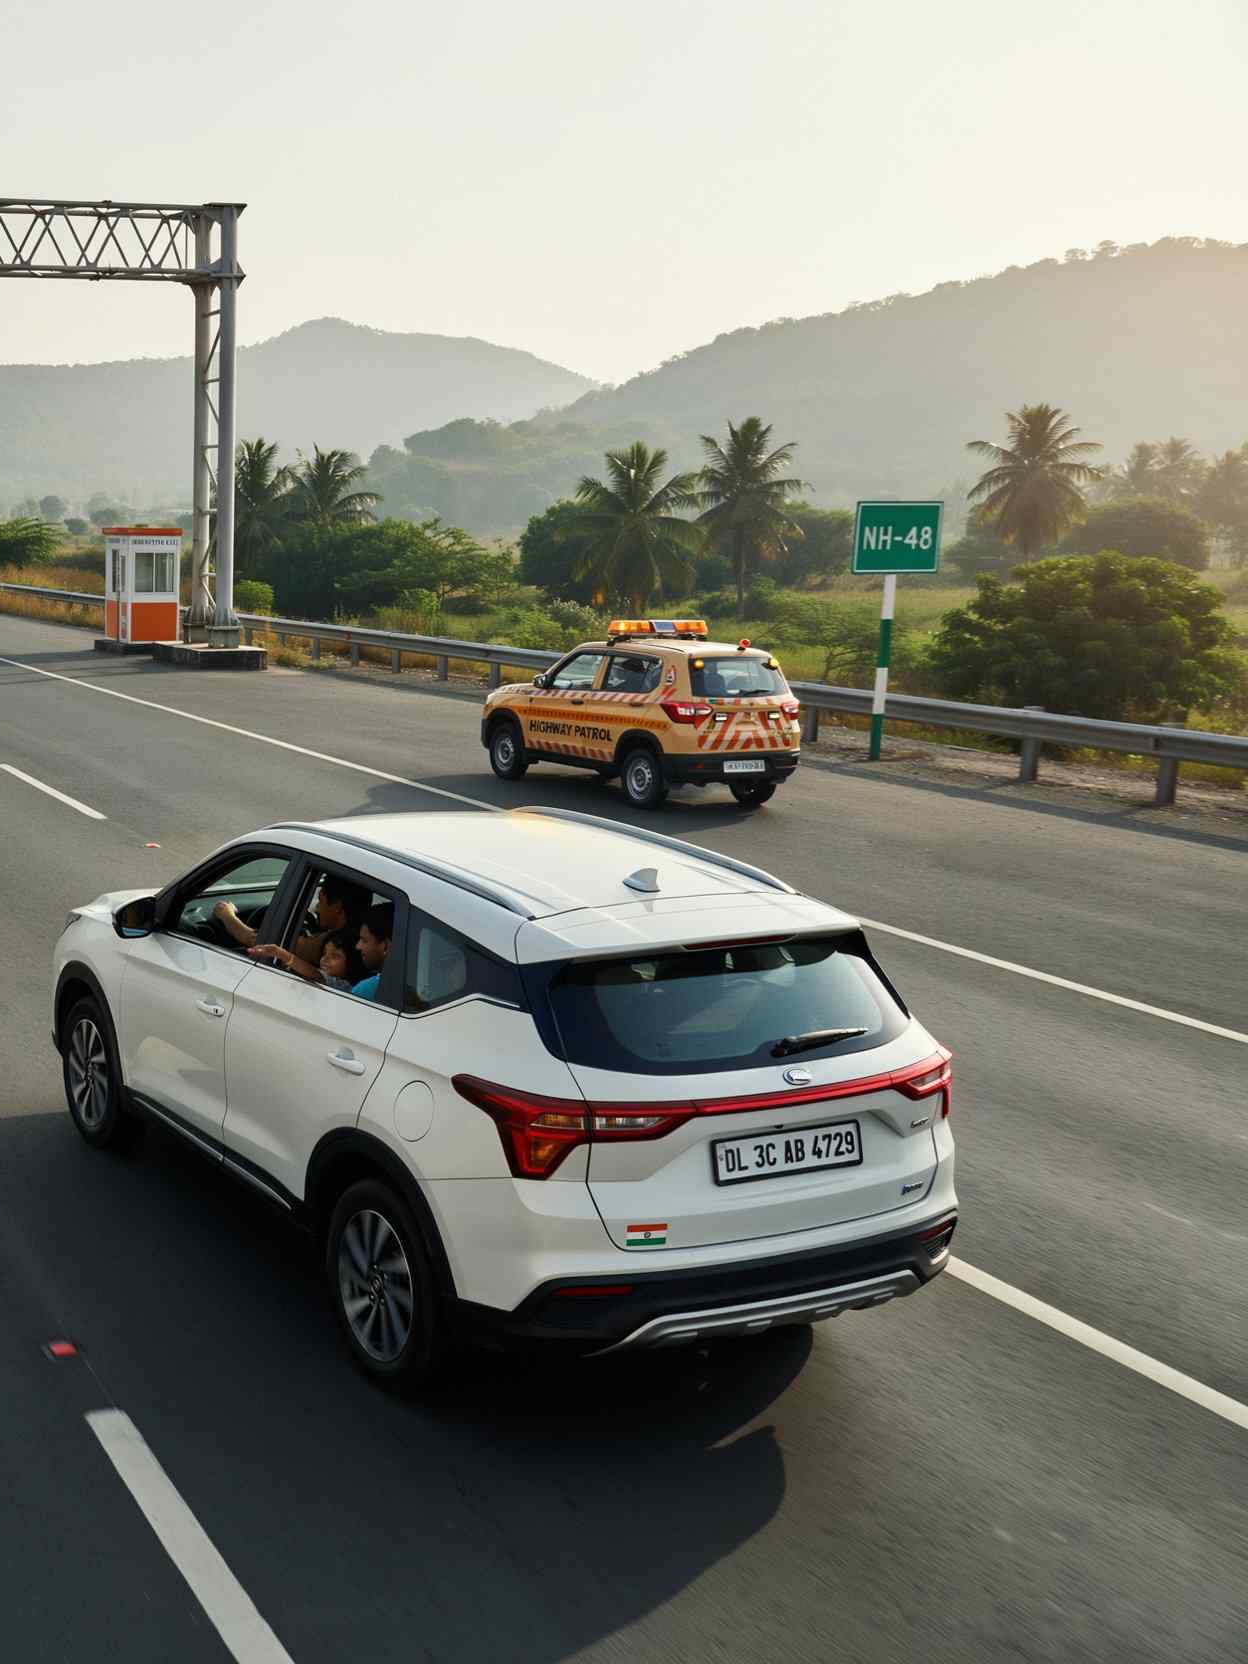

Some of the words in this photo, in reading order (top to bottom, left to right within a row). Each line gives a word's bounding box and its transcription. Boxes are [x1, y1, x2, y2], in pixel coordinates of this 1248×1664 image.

[863, 526, 933, 550] NH-48
[529, 719, 572, 737] HIGHWAY
[575, 725, 613, 741] PATROL
[725, 1147, 749, 1172] DL
[753, 1143, 777, 1168] 3C
[784, 1138, 806, 1164] AB
[811, 1131, 856, 1160] 4729
